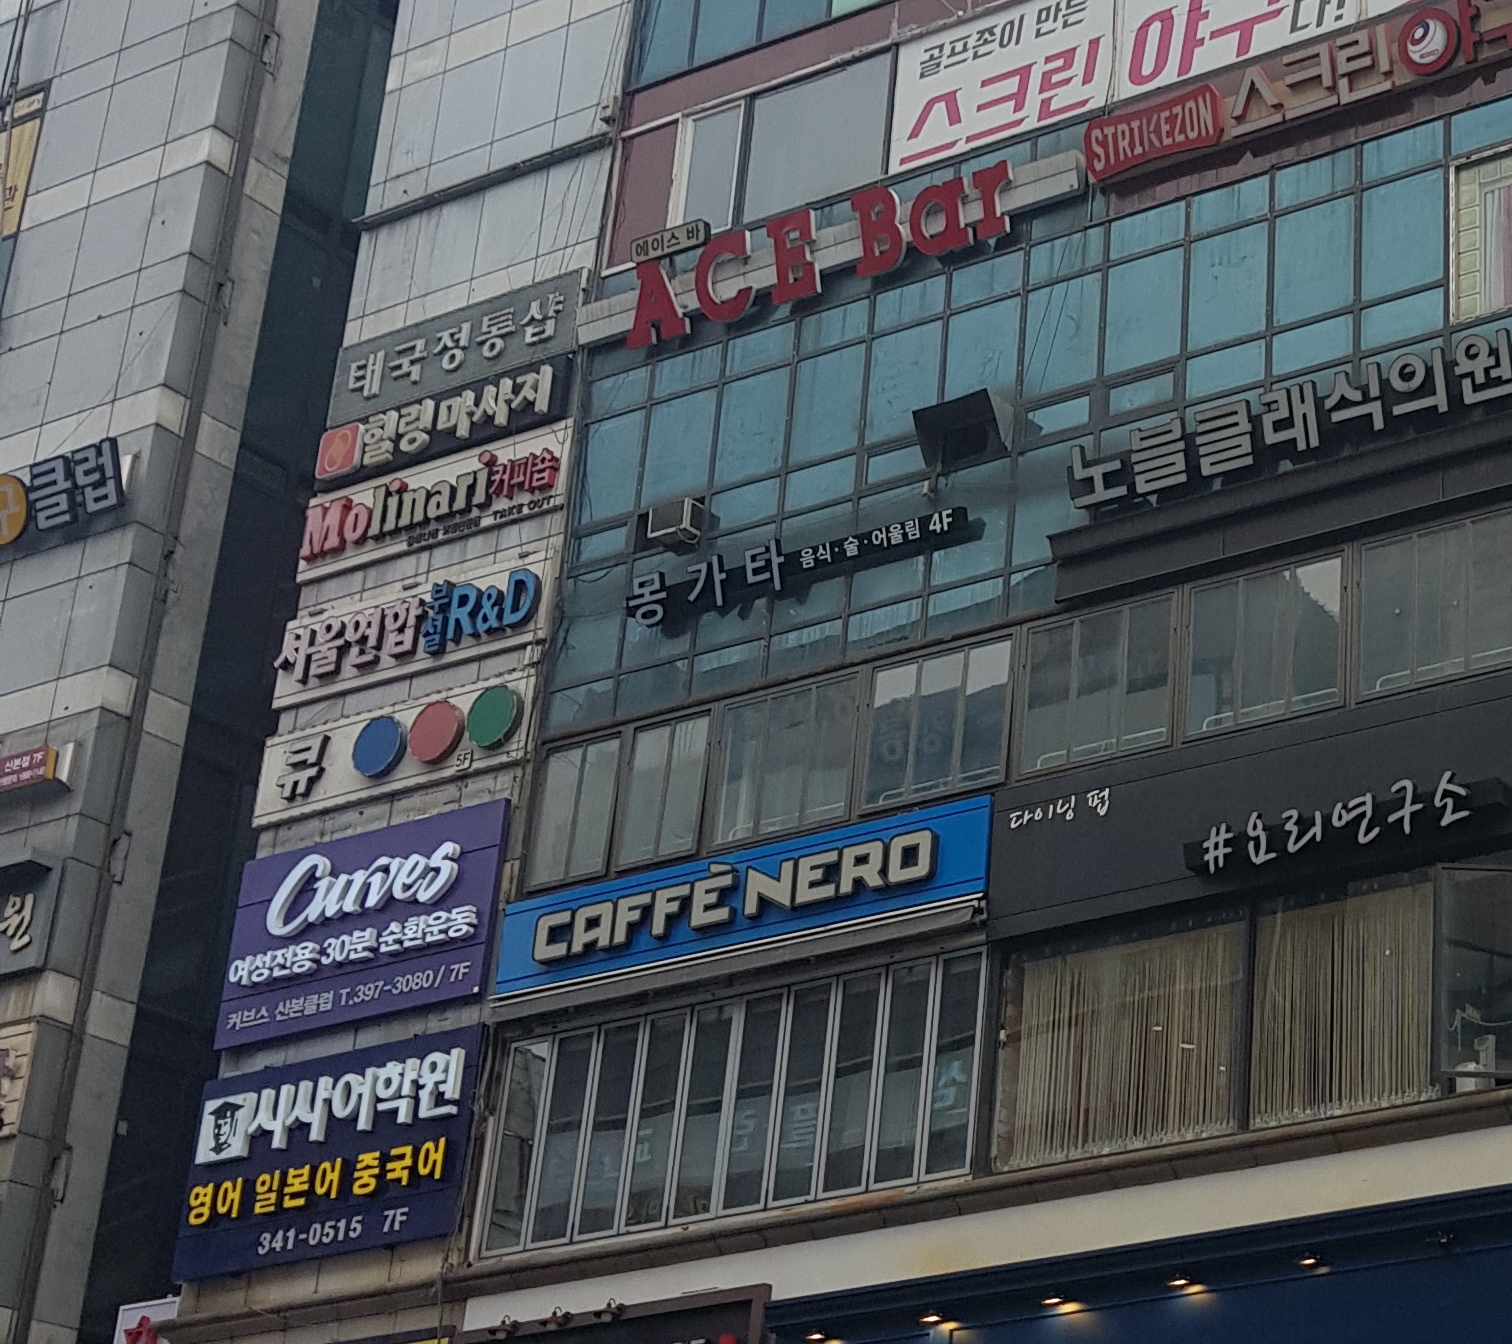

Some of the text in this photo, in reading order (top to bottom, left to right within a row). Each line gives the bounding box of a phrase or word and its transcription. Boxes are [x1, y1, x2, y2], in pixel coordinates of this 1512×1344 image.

[919, 15, 1025, 80] 골프존이
[1230, 20, 1396, 135] 스크린
[898, 34, 1106, 167] 스크린
[1089, 92, 1217, 176] STRIKEZON
[626, 160, 1014, 350] ACE Bar
[633, 223, 702, 258] 에이스 바
[360, 363, 555, 467] 힐링마사지
[300, 449, 499, 564] Molinari
[928, 509, 955, 535] 4F
[273, 596, 424, 686] 서울연합
[446, 568, 538, 641] R&D
[454, 751, 472, 771] 5F
[1008, 786, 1112, 830] 다이닝 펍
[1203, 769, 1472, 875] #요리연구소
[265, 840, 462, 940] Curves
[741, 828, 940, 919] NERO
[227, 904, 479, 988] 여성전용 30분 순환운동
[225, 1008, 271, 1032] 커브스
[274, 990, 335, 1021] 산본클럽
[448, 962, 473, 984] 7F
[247, 1047, 467, 1150] 시사어학원
[187, 1137, 448, 1226] 영어 일본어 중국어
[256, 1207, 409, 1256] 341-0515 7F
